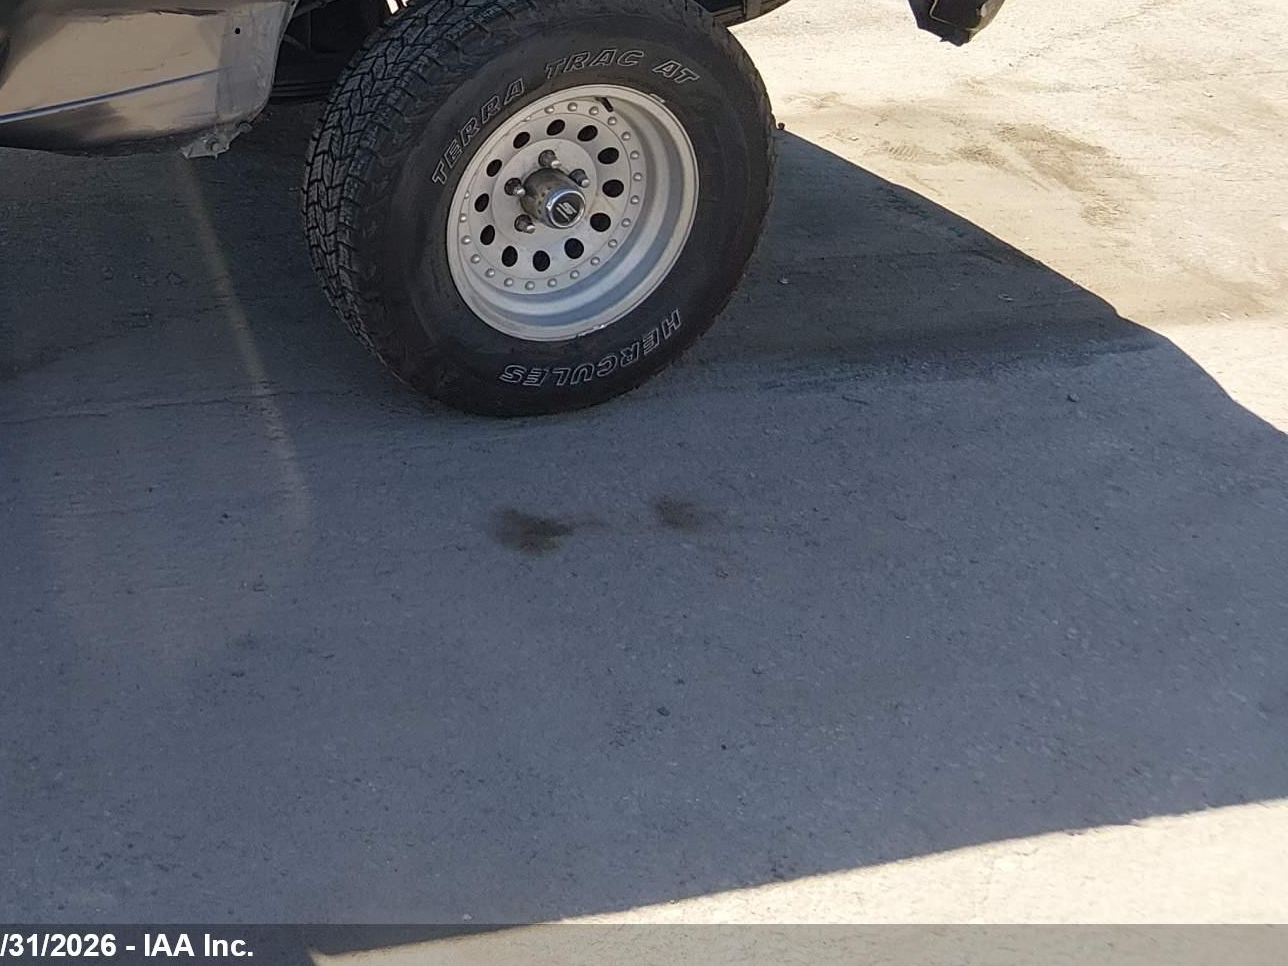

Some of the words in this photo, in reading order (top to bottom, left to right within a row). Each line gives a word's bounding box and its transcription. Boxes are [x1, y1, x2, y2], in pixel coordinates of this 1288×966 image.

[431, 77, 525, 186] TERRA
[544, 48, 644, 80] TRAC
[652, 60, 700, 84] AT
[499, 308, 682, 387] HERCULES
